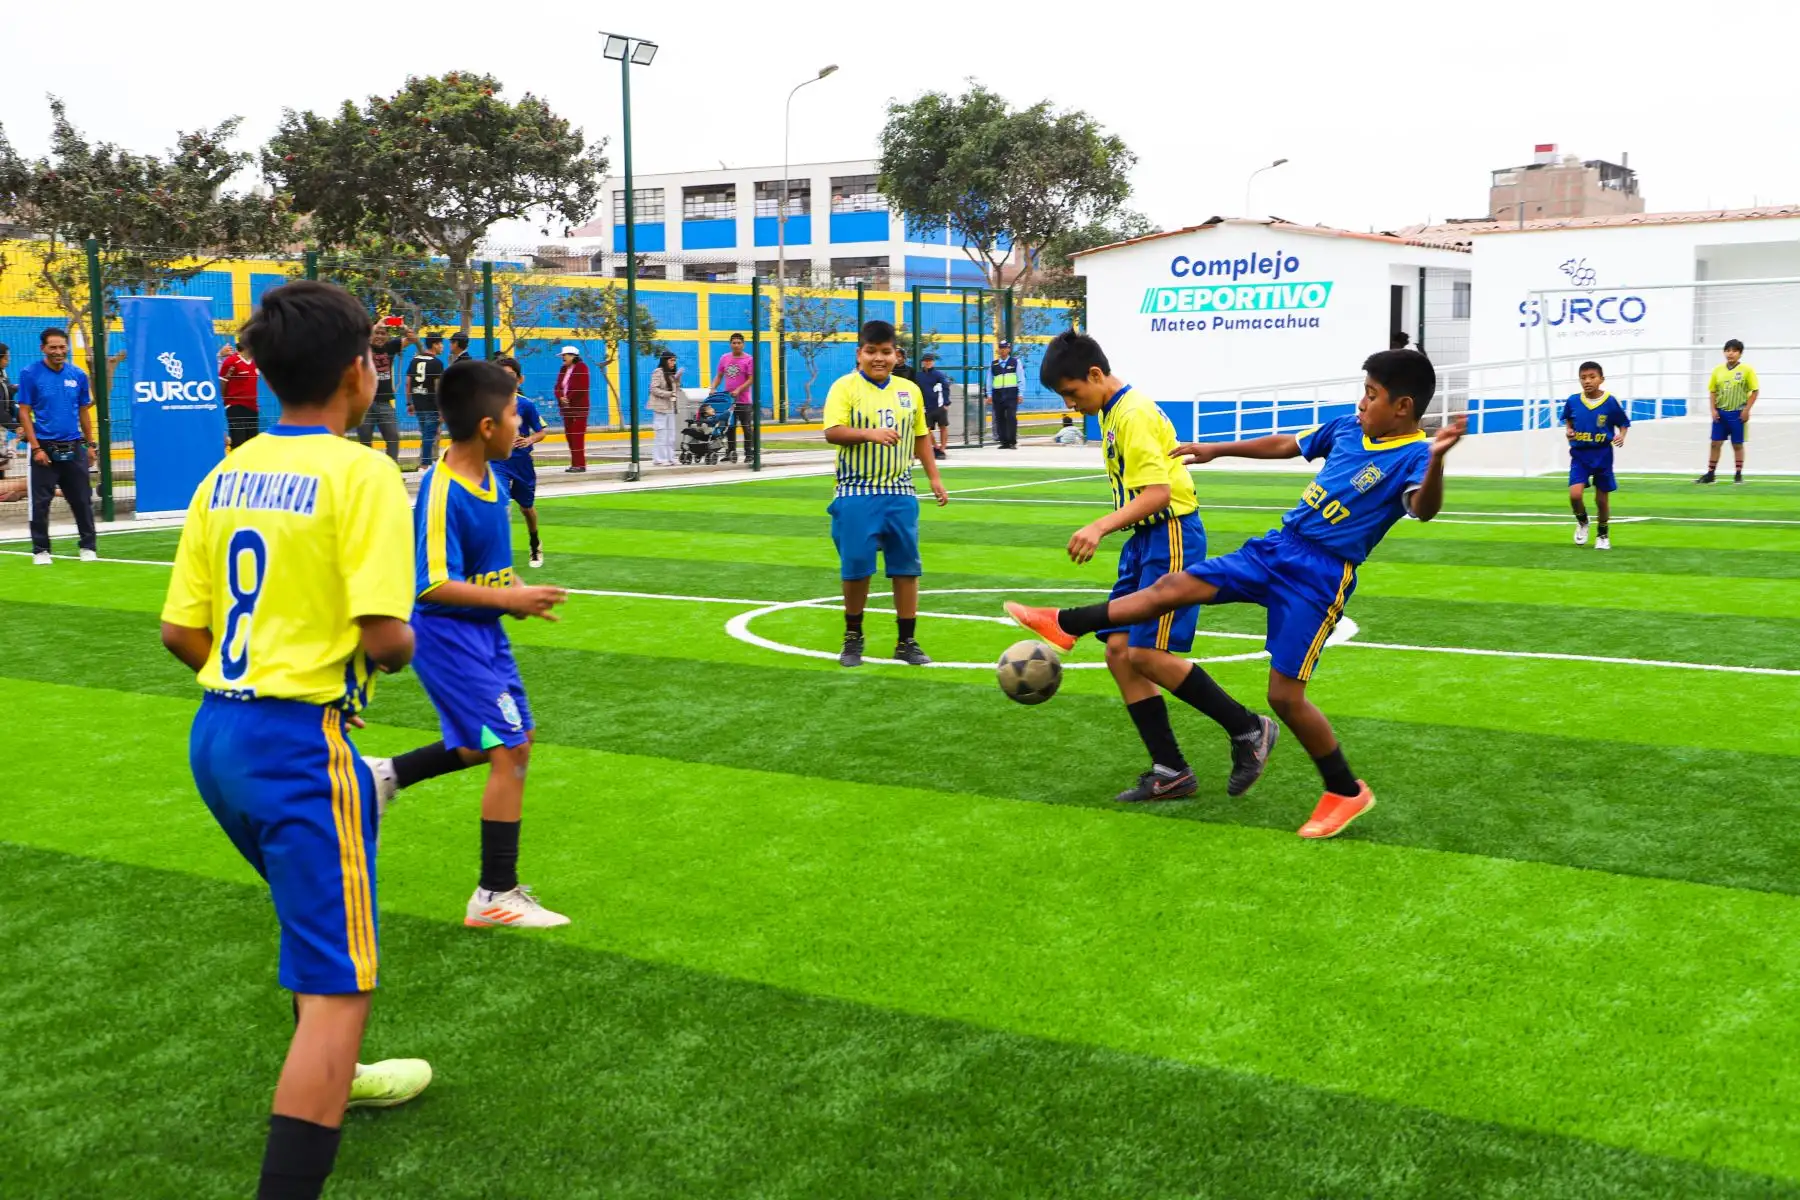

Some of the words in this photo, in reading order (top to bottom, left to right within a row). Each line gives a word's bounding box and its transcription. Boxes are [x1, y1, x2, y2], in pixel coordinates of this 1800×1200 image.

[1170, 250, 1300, 282] Complejo
[1156, 283, 1327, 312] DEPORTIVO
[1151, 317, 1207, 332] Mateo
[1212, 314, 1320, 331] Pumacahua
[1519, 296, 1646, 328] SURCO
[414, 361, 428, 383] 9
[134, 380, 217, 403] SURCO
[877, 408, 895, 429] 16
[1322, 499, 1351, 525] 07
[220, 527, 268, 682] 8
